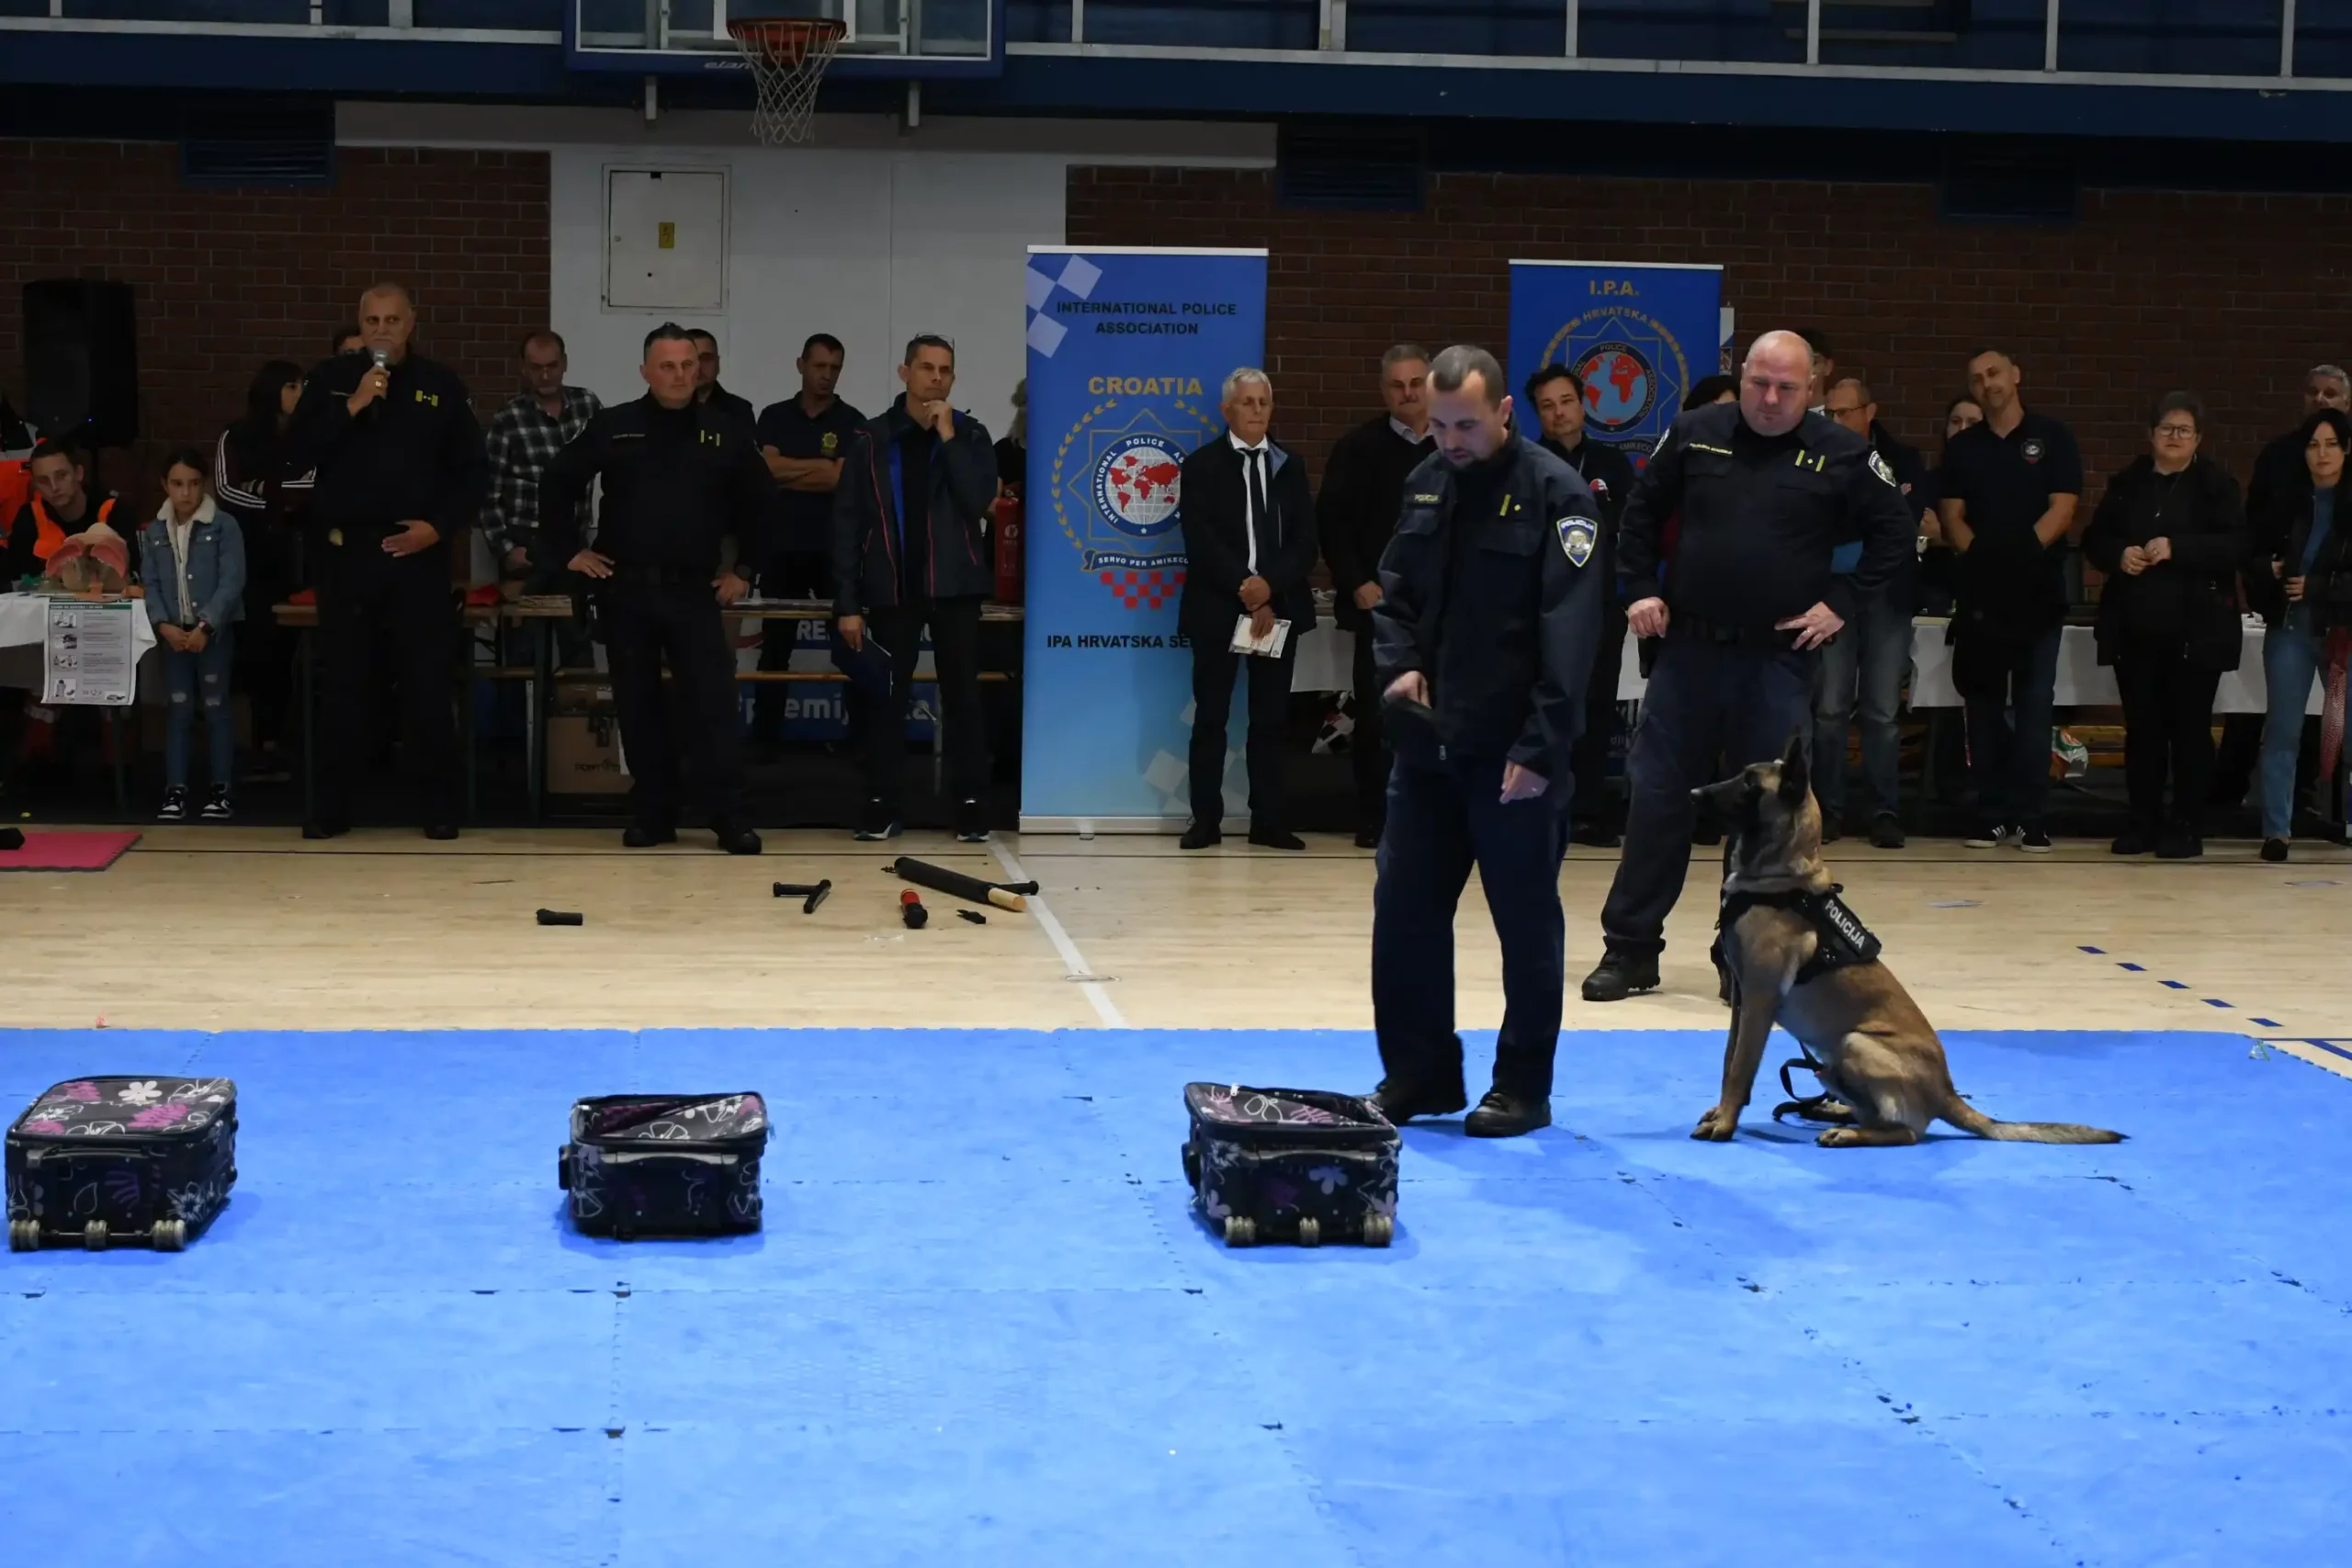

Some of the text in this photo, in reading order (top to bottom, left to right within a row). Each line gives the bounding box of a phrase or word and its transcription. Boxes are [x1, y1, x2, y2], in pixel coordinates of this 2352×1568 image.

[1589, 279, 1641, 297] I.P.A.
[1057, 301, 1237, 315] INTERNATIONAL POLICE
[1583, 306, 1648, 321] HRVATSKA
[1095, 322, 1199, 334] ASSOCIATION
[1600, 344, 1627, 353] POLICE
[1088, 377, 1204, 396] CROATIA
[1096, 437, 1166, 525] INTERNATIONAL POLICE
[1098, 556, 1127, 565] SERVO
[1046, 635, 1072, 648] IPA
[1078, 635, 1164, 648] HRVATSKA
[1825, 898, 1866, 950] POLICIJA
